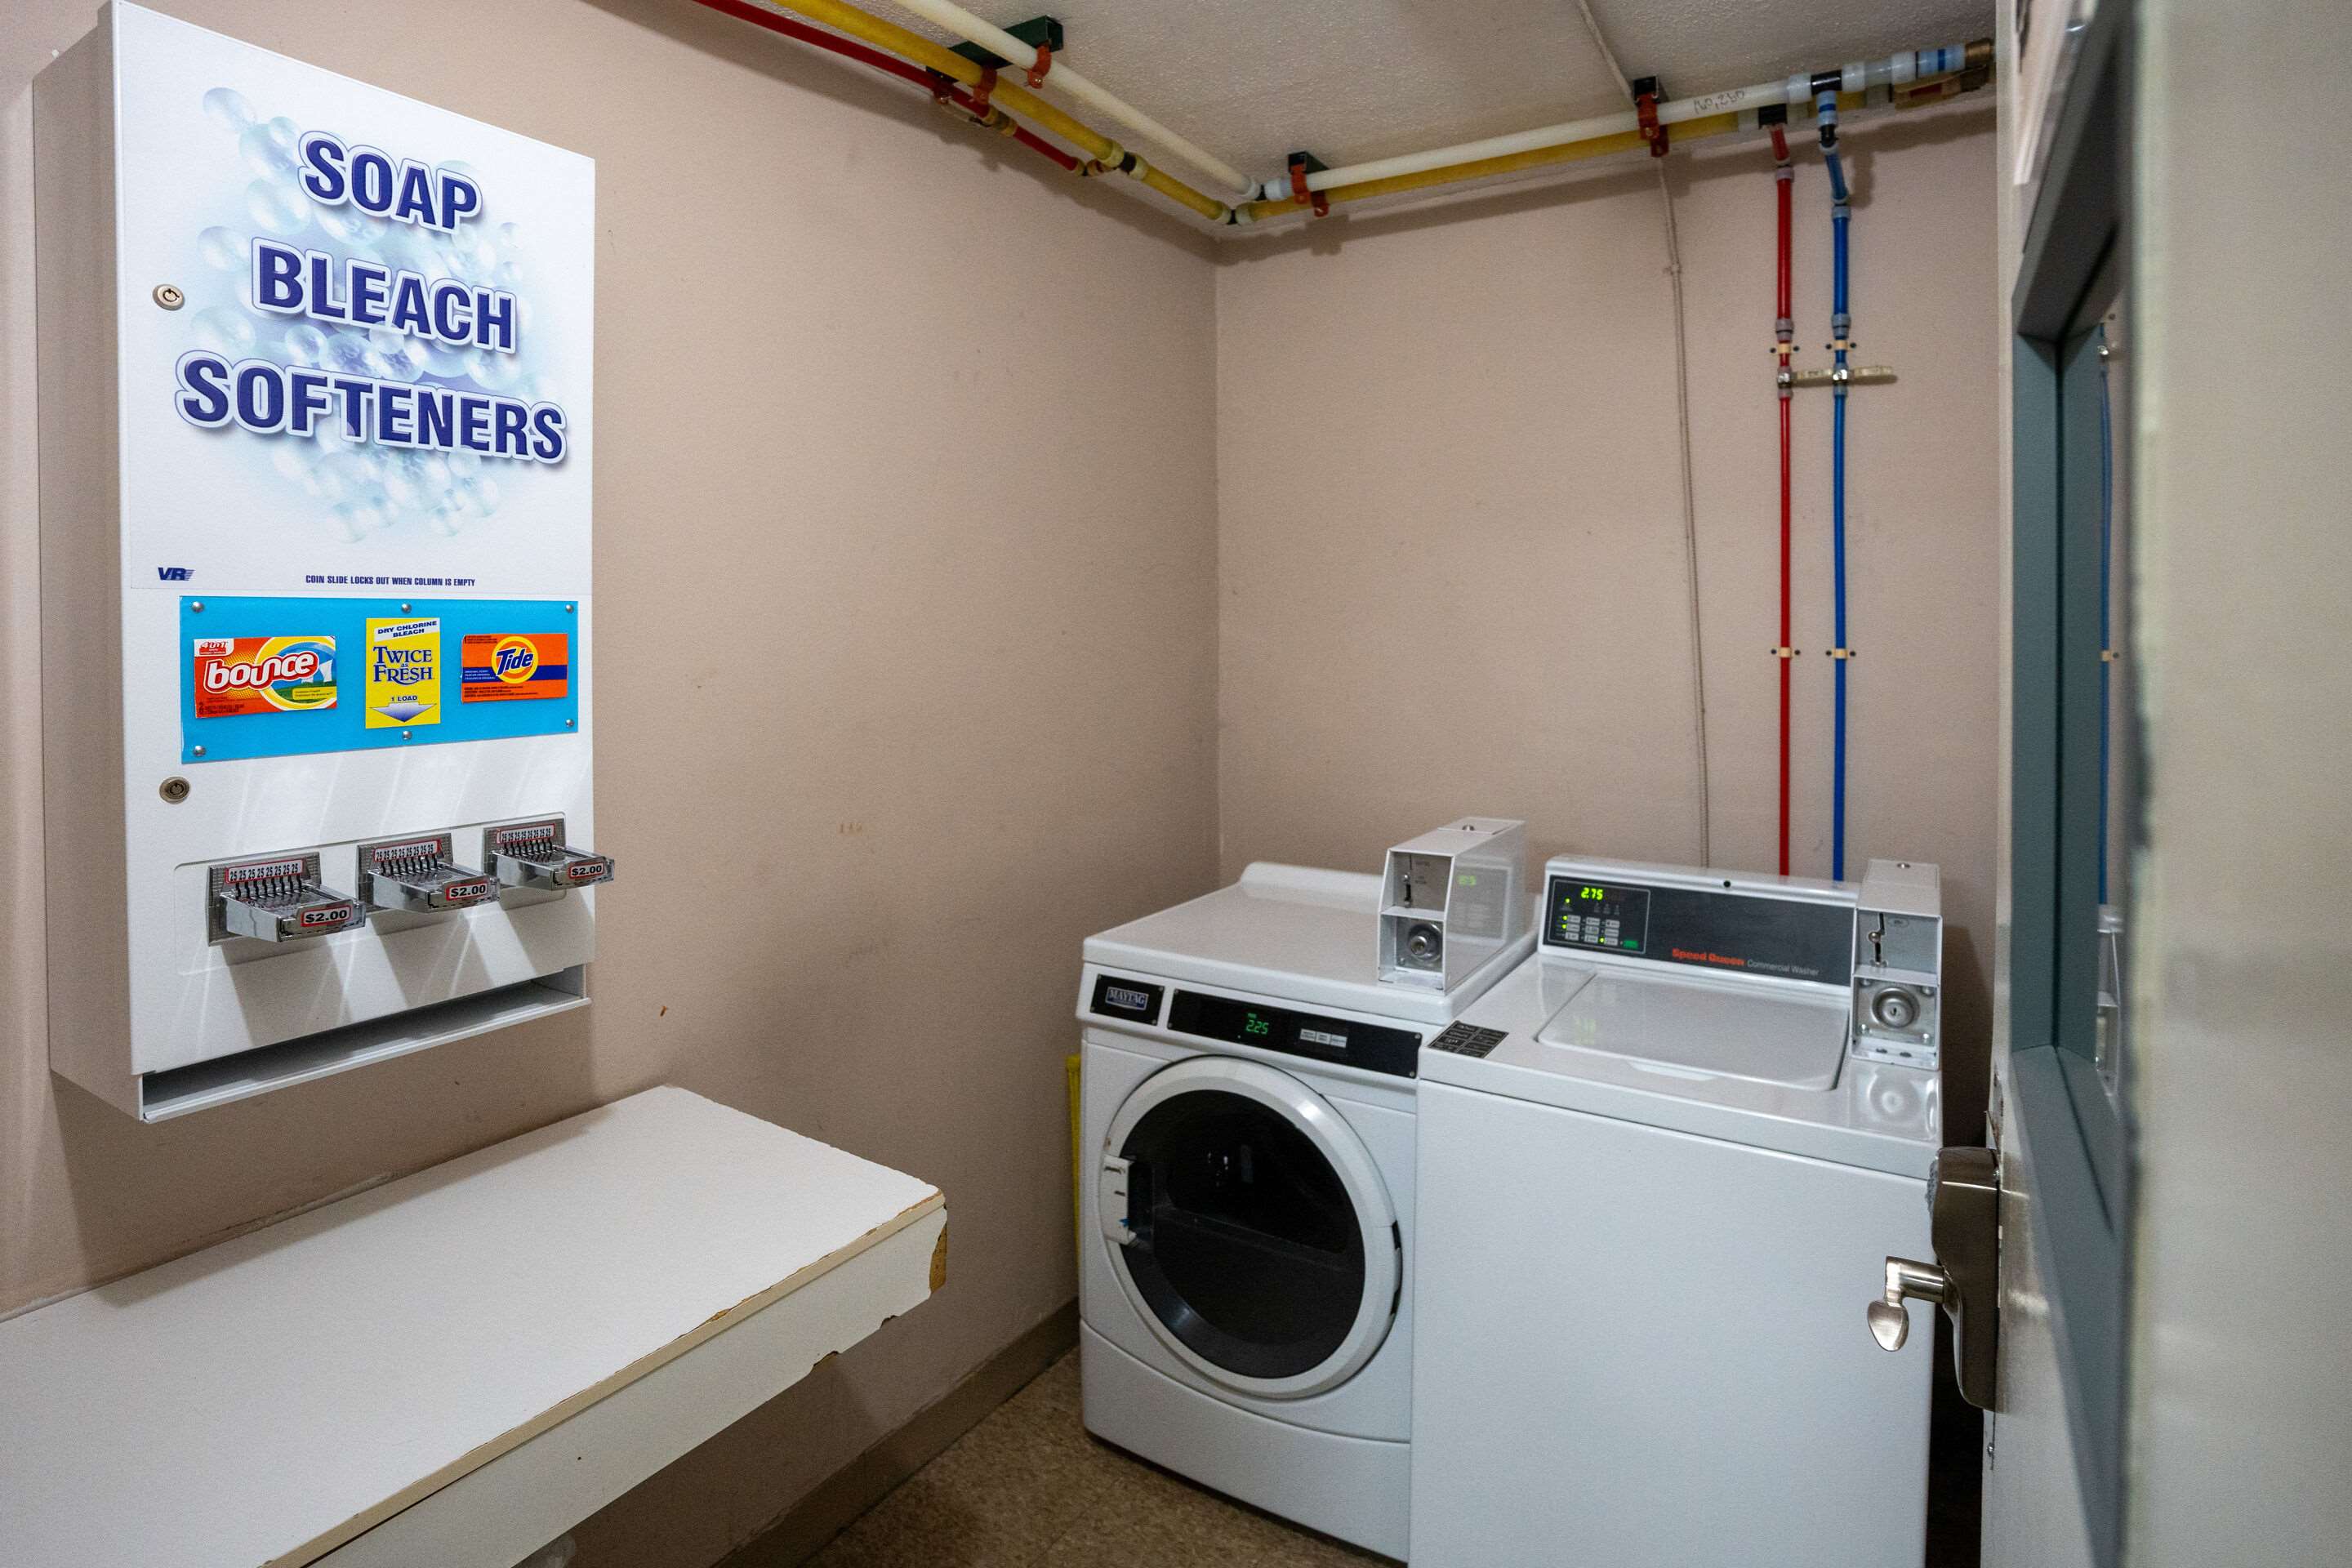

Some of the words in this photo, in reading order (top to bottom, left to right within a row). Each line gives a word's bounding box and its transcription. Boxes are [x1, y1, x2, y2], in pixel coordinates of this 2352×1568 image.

[303, 139, 479, 230] SOAP
[258, 245, 514, 350] BLEACH
[181, 358, 564, 460] SOFTENERS
[305, 575, 324, 583] COIN
[327, 576, 348, 584] SLIDE
[350, 577, 373, 585] LOCKS
[376, 577, 390, 585] OUT
[445, 578, 452, 586] IS
[393, 628, 425, 638] BLEACH
[396, 621, 437, 631] CHLORINE
[373, 646, 432, 664] TWICE
[496, 648, 534, 676] Tide
[206, 653, 316, 690] bounce
[373, 664, 433, 685] FRESH
[502, 833, 507, 841] 25
[509, 832, 513, 840] 25
[515, 831, 519, 840] 25
[521, 831, 526, 839] 25
[533, 830, 538, 838] 25
[540, 829, 545, 837] 25
[546, 828, 550, 836] 25
[376, 852, 381, 861] 25
[384, 850, 390, 859] 25
[391, 849, 397, 858] 25
[399, 849, 404, 857] 25
[407, 848, 412, 856] 25
[413, 847, 419, 855] 25
[421, 845, 426, 854] 25
[428, 844, 433, 853] 25
[230, 871, 237, 881] 25
[239, 870, 247, 880] 25
[248, 869, 255, 879] 25
[257, 867, 265, 878] 25
[266, 866, 273, 876] 25
[274, 866, 281, 875] 25
[283, 864, 290, 874] 25
[292, 863, 298, 873] 25
[572, 866, 602, 876] $2.00
[451, 885, 486, 897] $2.00
[1580, 887, 1603, 900] 2.75
[305, 910, 347, 923] $2.00
[1672, 947, 1707, 960] Speed
[1747, 959, 1790, 973] Commercial
[1792, 965, 1820, 976] Washer
[1109, 989, 1145, 1004] MAYTAG
